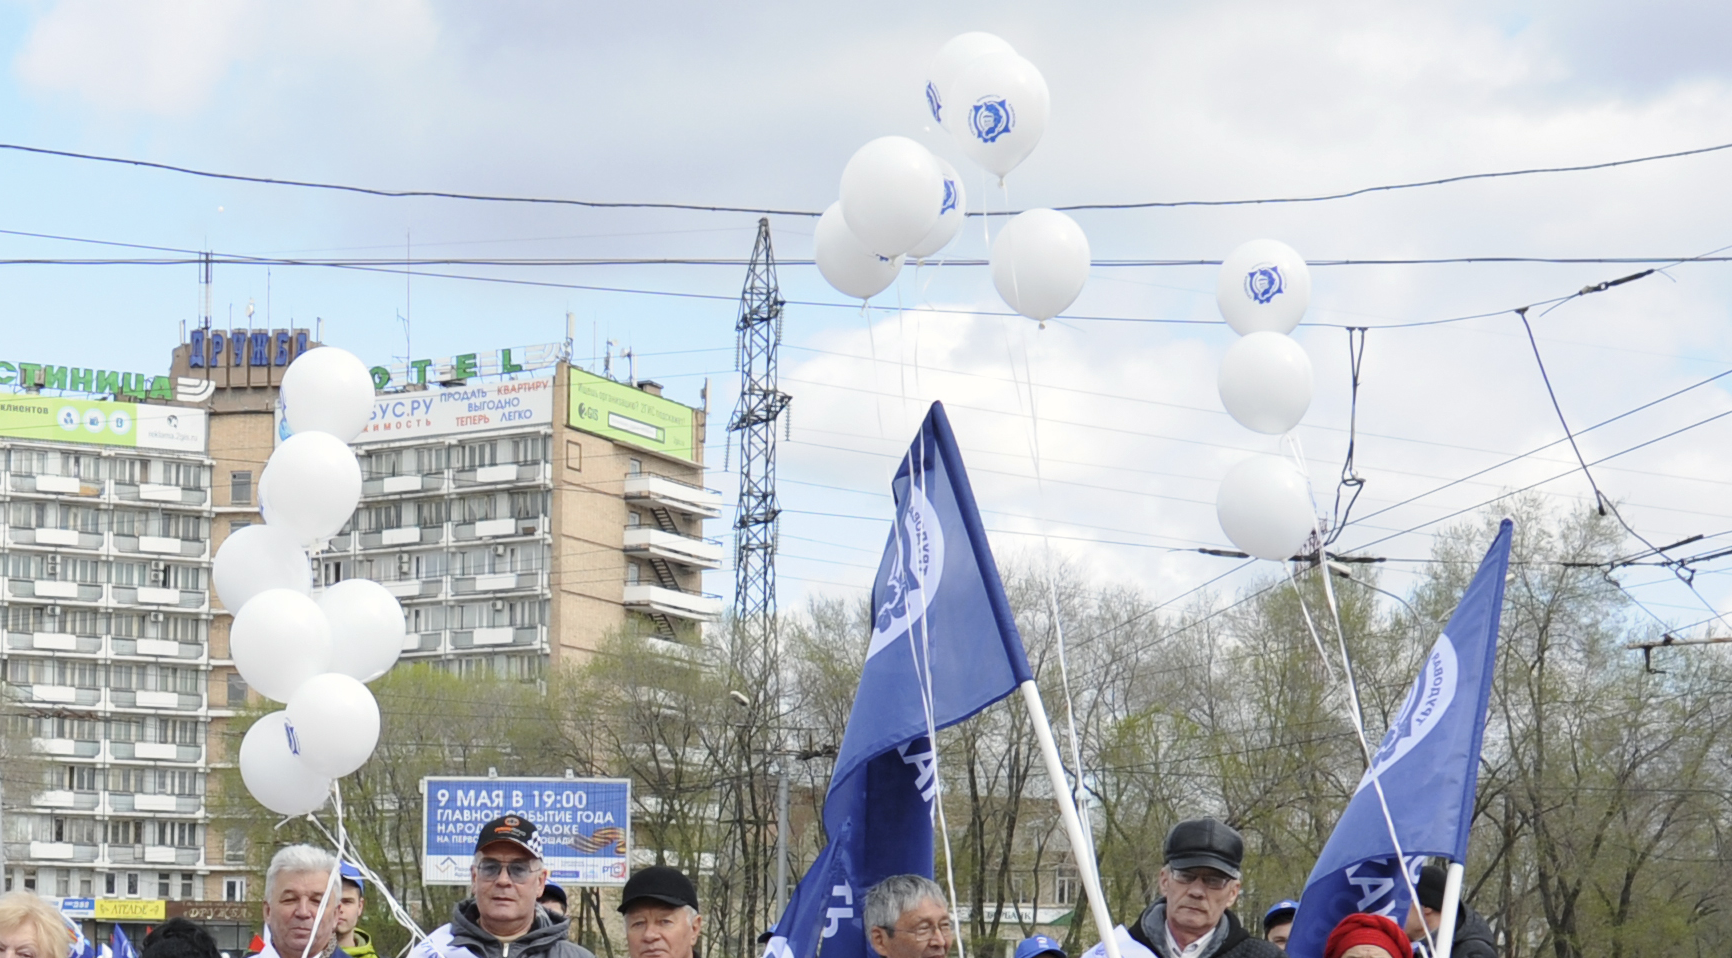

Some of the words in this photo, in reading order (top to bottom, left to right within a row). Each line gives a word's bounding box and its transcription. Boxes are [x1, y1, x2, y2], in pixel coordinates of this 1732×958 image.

[190, 330, 307, 368] ДРУЖБА
[369, 348, 523, 389] OTEL
[440, 388, 487, 403] ПРОДАТЬ
[497, 380, 549, 395] КВАРТИРУ
[0, 405, 49, 414] клиентов
[467, 397, 521, 412] ВЫГОДНО
[455, 414, 490, 427] ТЕПЕРЬ
[500, 409, 533, 422] ЛЕГКО
[437, 789, 449, 807] 9
[456, 790, 504, 807] МАЯ
[512, 791, 523, 807] В
[533, 791, 587, 808] 19:00
[437, 809, 501, 821] ГЛАВНОЕ
[577, 811, 615, 824] ГОДА
[437, 823, 483, 834] НАРОД
[537, 824, 579, 835] РАОКЕ
[436, 835, 449, 843] НА
